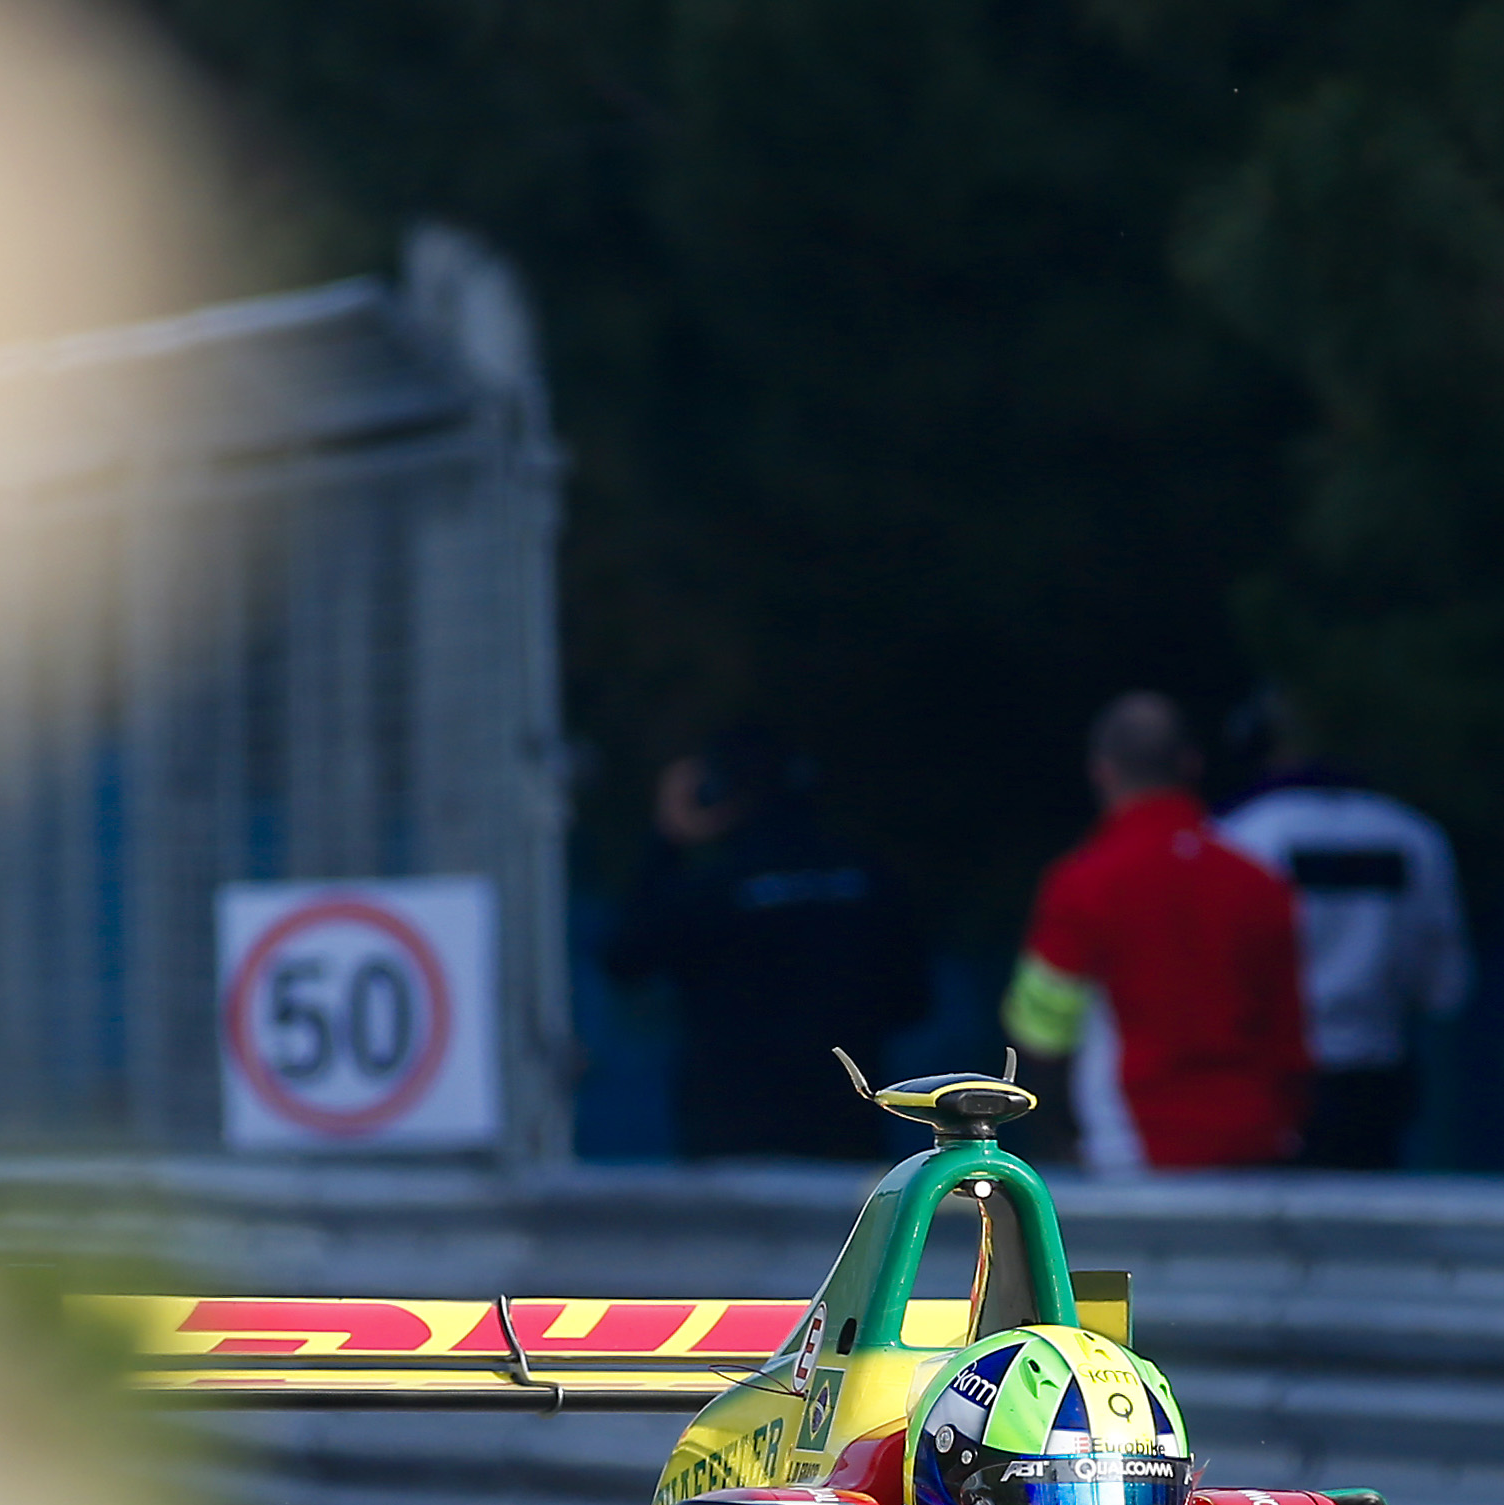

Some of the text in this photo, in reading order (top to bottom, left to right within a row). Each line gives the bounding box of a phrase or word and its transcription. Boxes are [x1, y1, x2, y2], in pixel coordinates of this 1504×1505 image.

[272, 957, 412, 1080] 50
[1000, 1461, 1050, 1482] ABT
[1074, 1458, 1174, 1482] QUALCOMM
